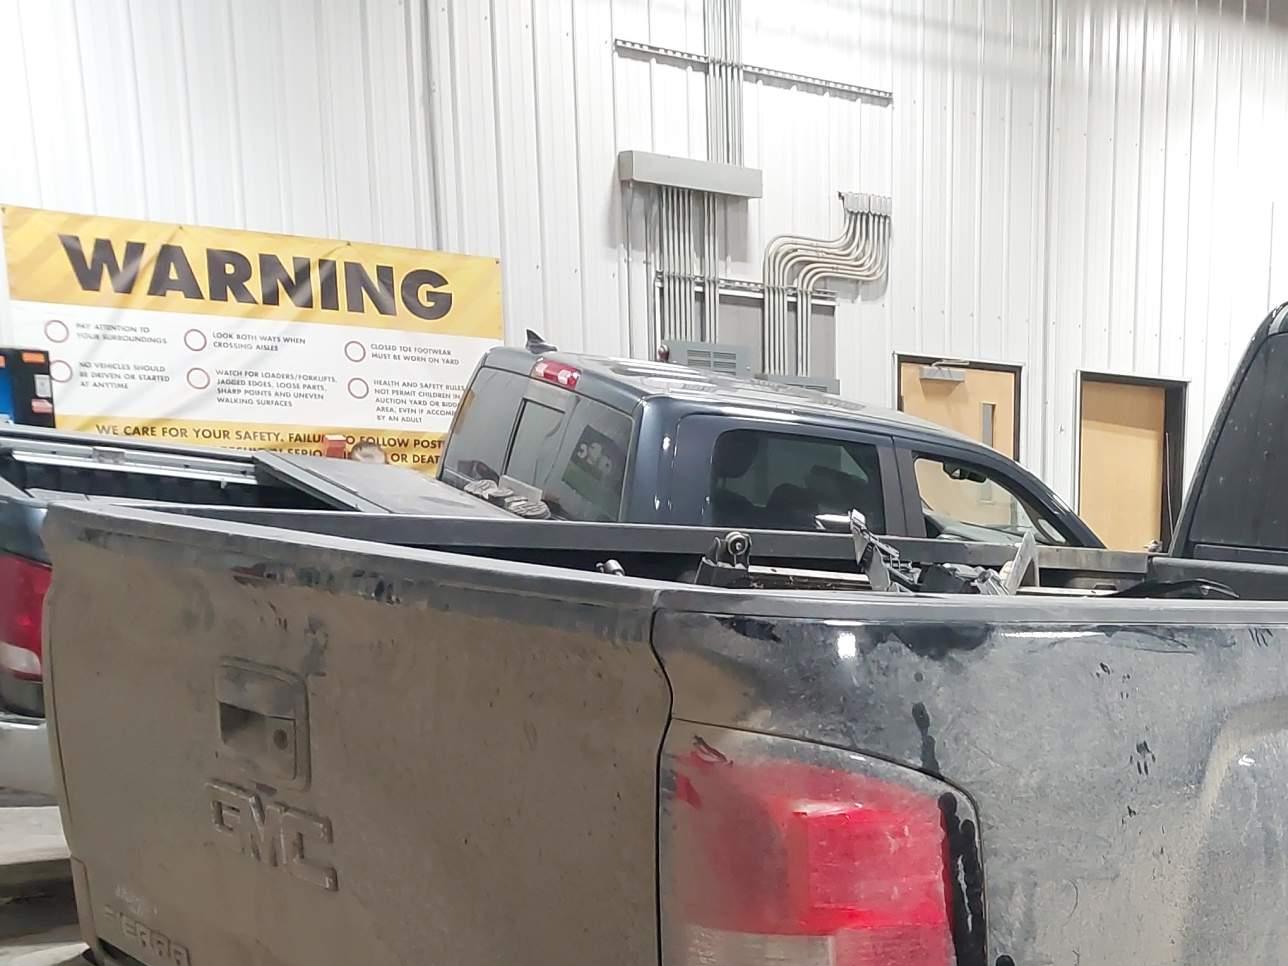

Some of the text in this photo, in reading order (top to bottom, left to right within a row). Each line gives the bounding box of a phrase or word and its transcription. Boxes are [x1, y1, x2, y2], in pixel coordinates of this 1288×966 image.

[59, 232, 453, 321] WARNING
[95, 324, 138, 333] ATTENTION
[102, 333, 168, 345] SURROUNDINGS
[212, 331, 306, 345] LOOK BOTH WAYS WHEN
[213, 341, 278, 352] CROSSING AISLES
[370, 343, 452, 356] CLOSED TOE FOOTWEAR
[371, 352, 391, 360] MUST
[403, 355, 427, 363] WORN
[428, 356, 440, 364] ON
[441, 357, 460, 366] YARD
[79, 361, 166, 373] NO VEHICLES SHOULD
[91, 371, 121, 380] DRIVEN
[138, 374, 170, 382] STARTED
[215, 369, 243, 377] WATCH
[244, 370, 259, 378] FOR
[217, 378, 246, 387] JAGGED
[276, 382, 300, 390] LOOSE
[373, 379, 465, 392] HEALTH AND SAFETY RULES
[217, 387, 324, 400] SHARP POINTS AND UNEVEN
[374, 388, 389, 396] NOT
[391, 389, 416, 398] PERMIT
[418, 390, 451, 400] CHILDREN
[216, 396, 293, 408] WALKING SURFACES
[375, 397, 459, 409] AUCTION YARD OR BIDD
[398, 407, 417, 415] EVEN
[388, 415, 399, 423] AN
[401, 415, 423, 424] ADULT
[96, 424, 119, 435] WE
[123, 425, 157, 437] CARE
[162, 426, 188, 438] FOR
[192, 428, 231, 440] YOUR
[235, 430, 285, 442] SAFETY.
[289, 432, 325, 444] FAILU
[360, 436, 409, 448] FOLLOW
[413, 439, 444, 450] POST
[390, 452, 408, 463] OR
[412, 453, 441, 464] DEAT
[204, 776, 339, 891] GMC
